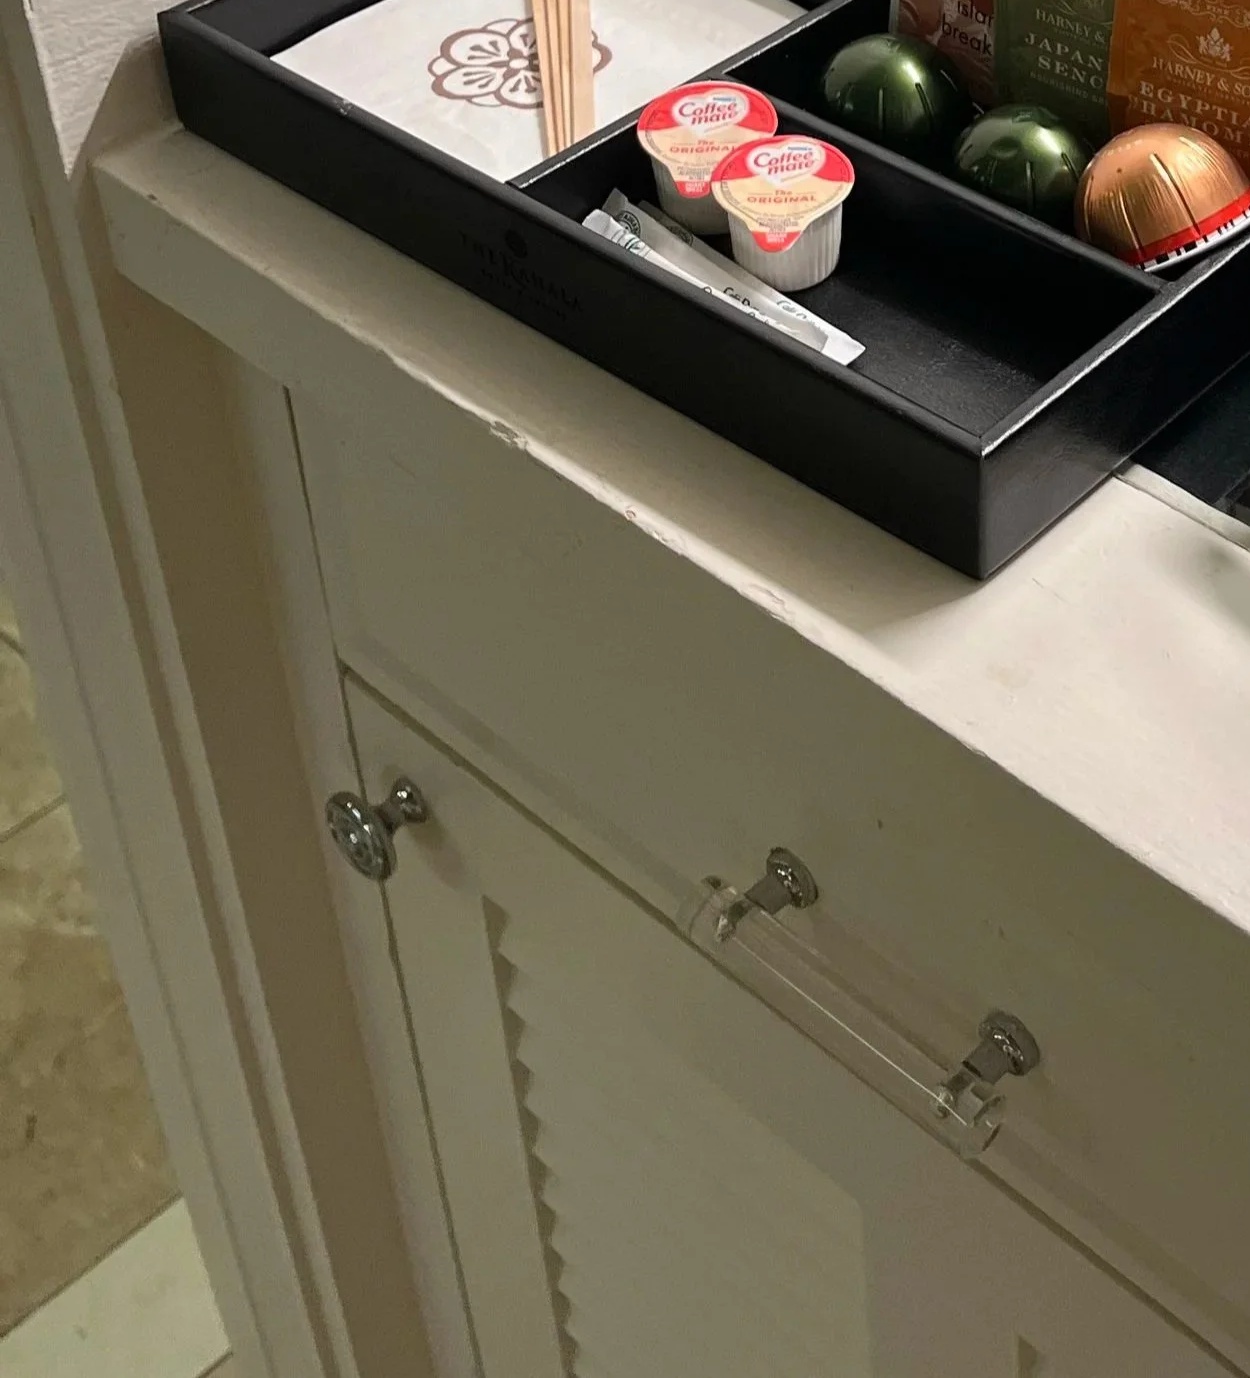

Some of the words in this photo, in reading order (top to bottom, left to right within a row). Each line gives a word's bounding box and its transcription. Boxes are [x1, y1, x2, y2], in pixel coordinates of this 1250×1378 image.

[1036, 8, 1090, 41] HARNEY
[941, 13, 993, 56] break
[1024, 32, 1104, 71] JAPAN
[1152, 56, 1215, 86] HARNEY
[1217, 77, 1230, 93] &
[678, 101, 738, 119] Coffee
[690, 109, 739, 126] mate
[753, 150, 814, 169] Coffee
[767, 159, 815, 176] mate
[746, 194, 816, 204] ORIGINAL
